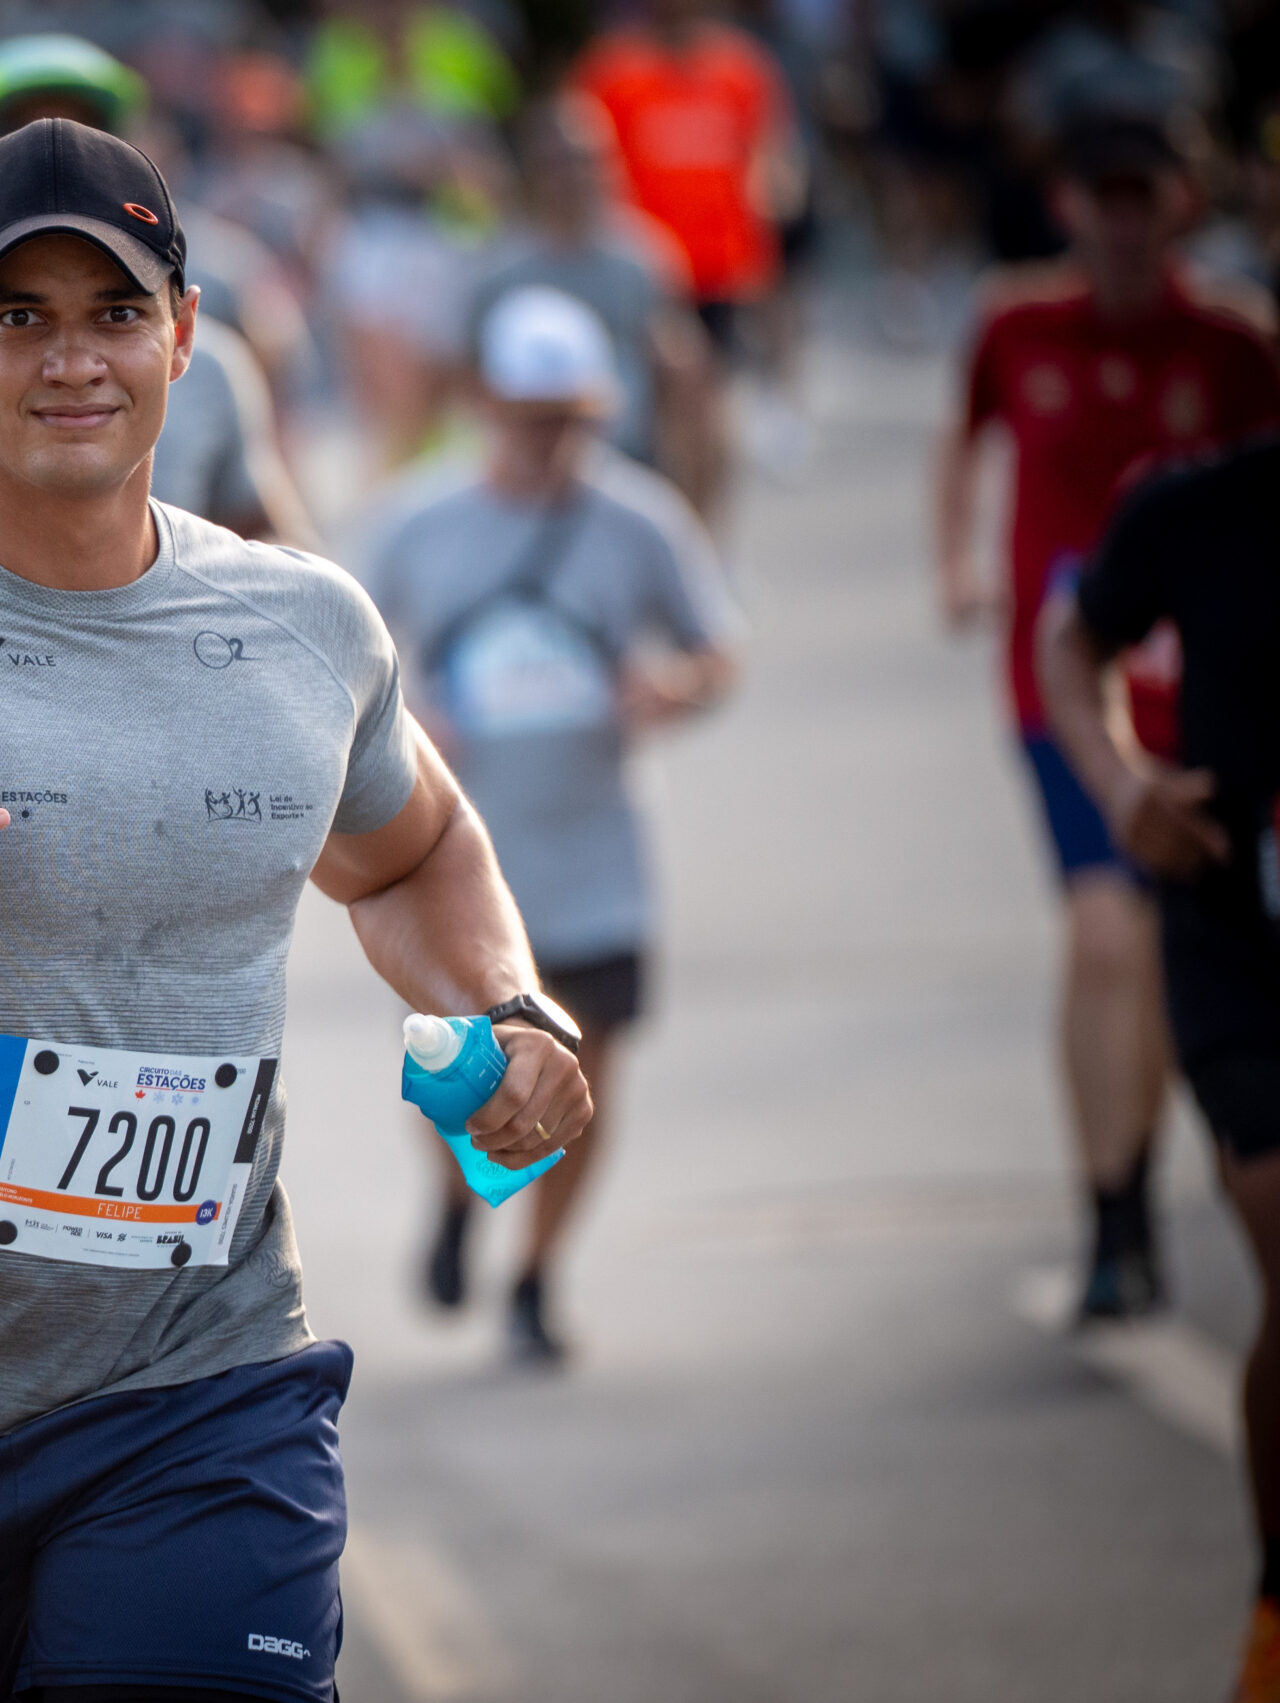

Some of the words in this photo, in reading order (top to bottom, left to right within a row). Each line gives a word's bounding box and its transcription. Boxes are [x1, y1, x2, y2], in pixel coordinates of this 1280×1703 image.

[7, 653, 57, 667] VALE
[1, 790, 68, 804] ESTAÇÕES
[139, 1066, 170, 1075] CIRCUITO
[97, 1079, 119, 1089] VALE
[136, 1074, 207, 1092] ESTAÇÕES
[57, 1106, 211, 1202] 7200
[97, 1203, 143, 1220] FELIPE
[96, 1231, 113, 1240] VISA
